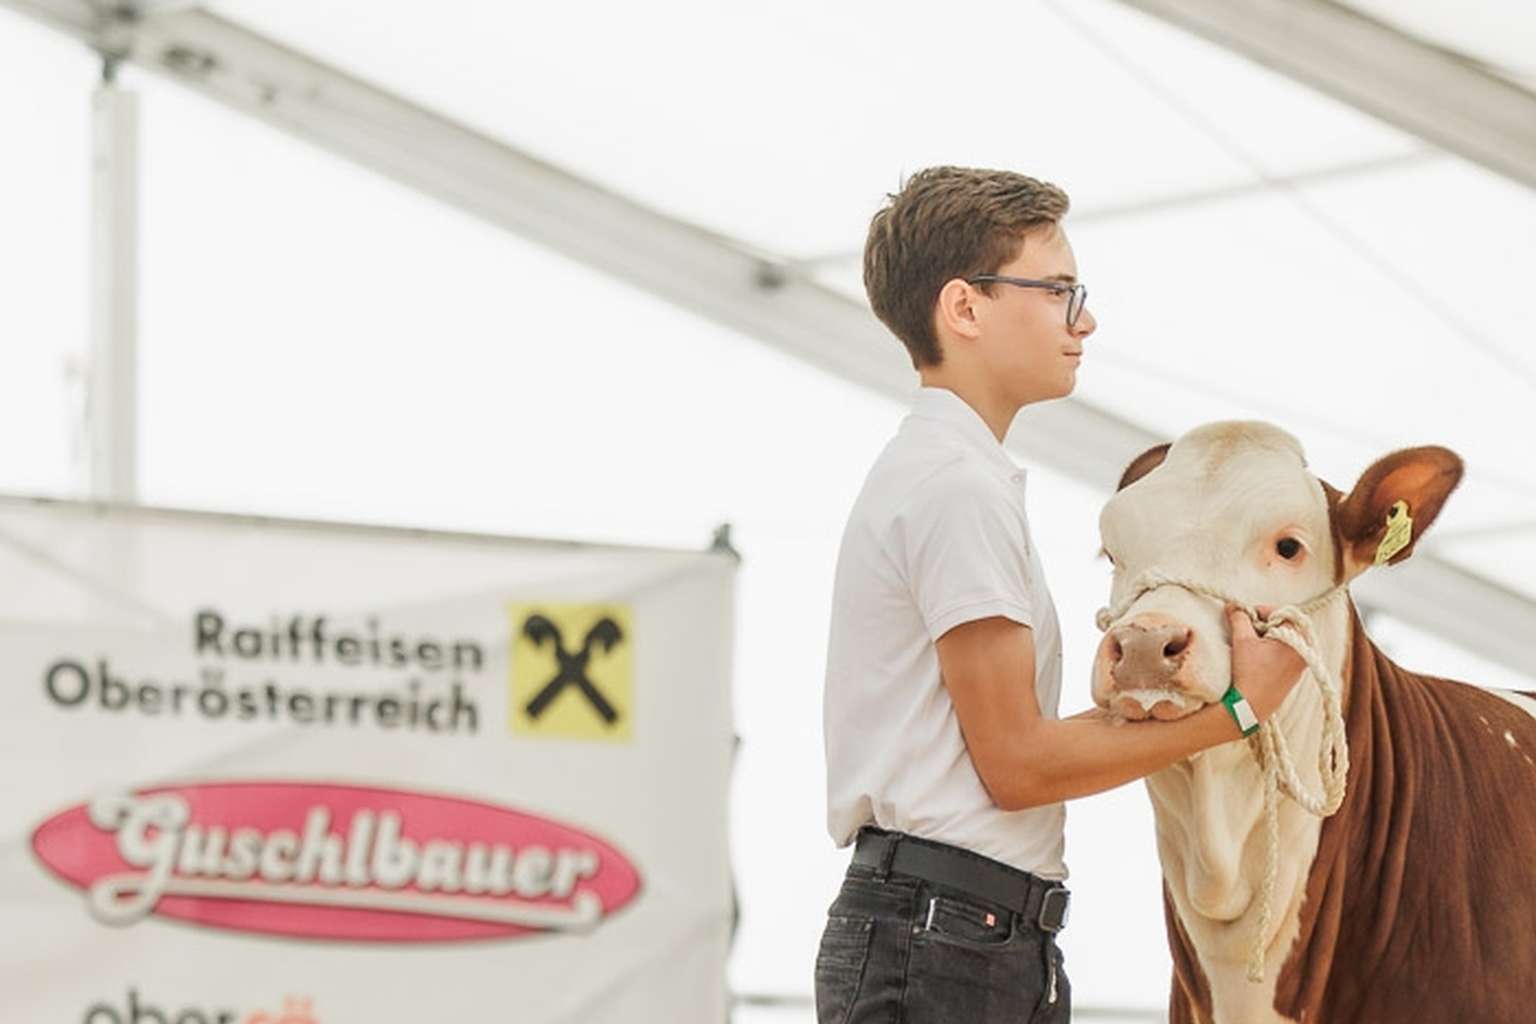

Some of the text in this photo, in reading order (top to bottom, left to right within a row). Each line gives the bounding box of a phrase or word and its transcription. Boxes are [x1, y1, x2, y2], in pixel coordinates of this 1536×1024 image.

[193, 609, 484, 672] Raiffeisen
[44, 661, 479, 734] Oberösterreich
[88, 788, 605, 934] Guschlbauer
